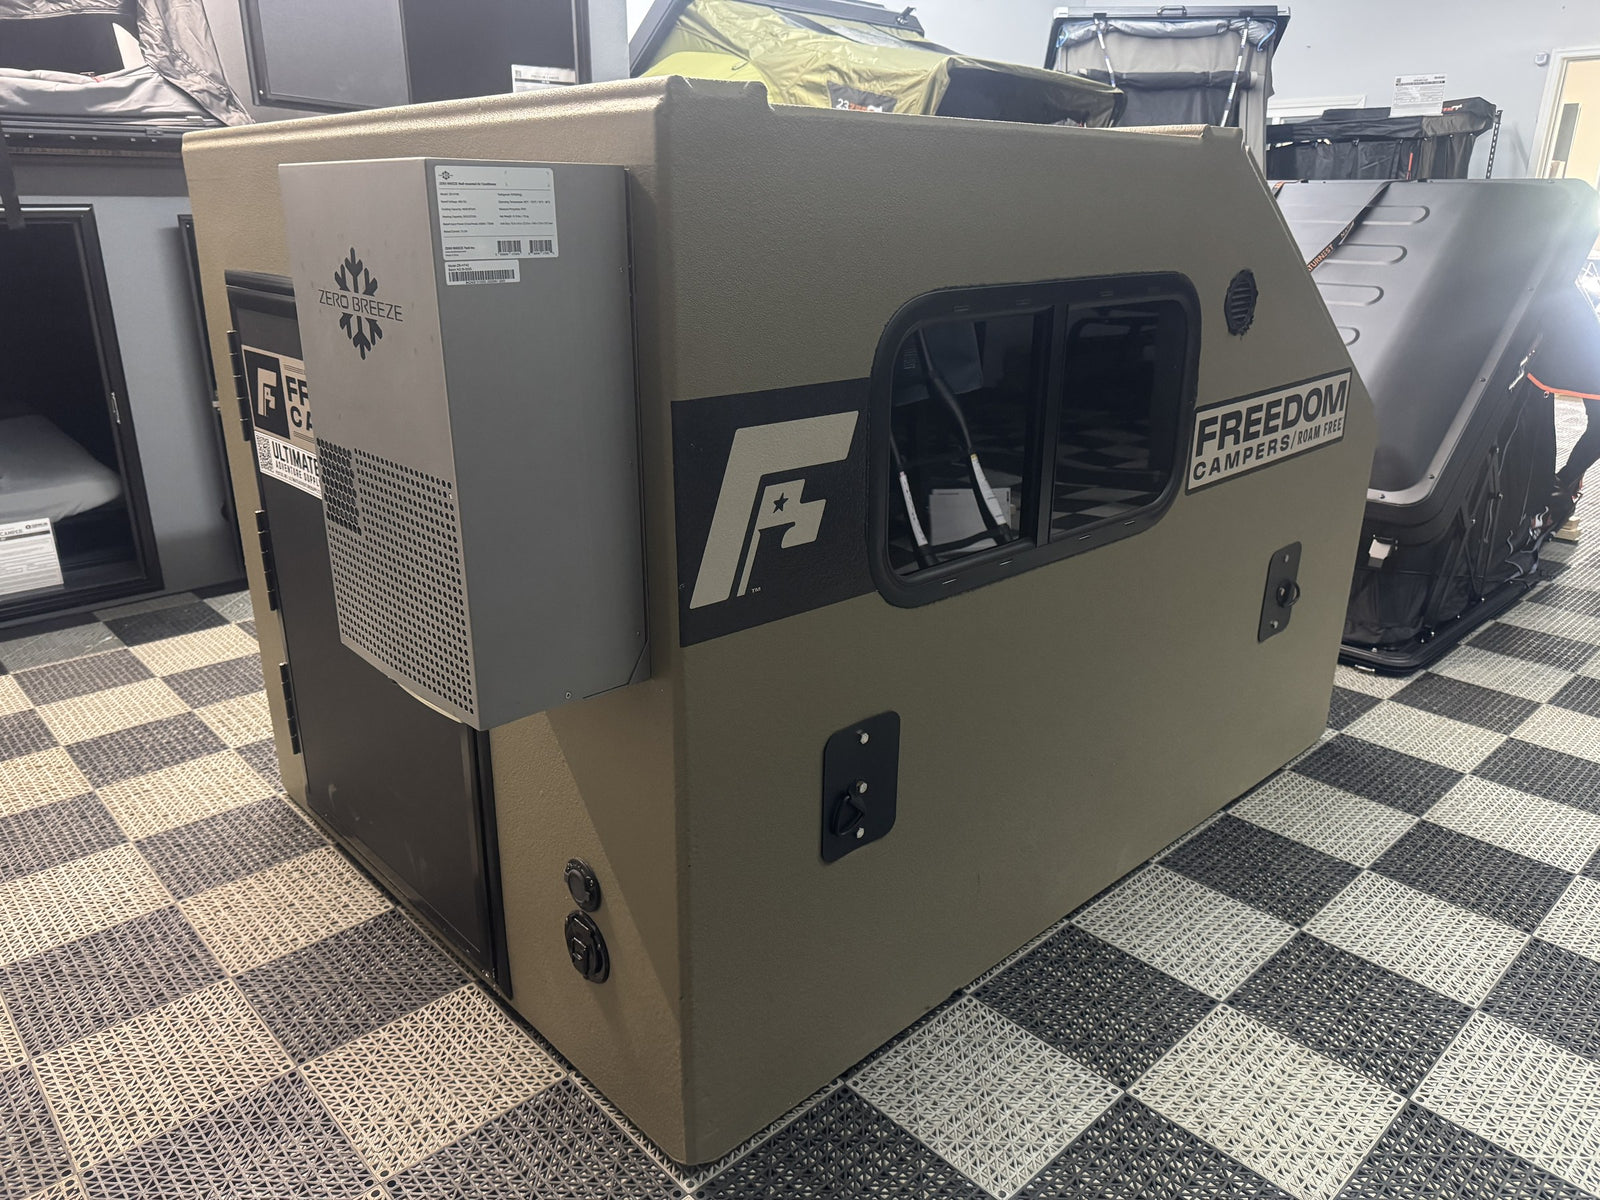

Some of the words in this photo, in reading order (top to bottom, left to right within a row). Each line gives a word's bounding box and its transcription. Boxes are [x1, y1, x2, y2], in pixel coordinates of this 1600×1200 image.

[318, 289, 349, 309] ZERO
[352, 296, 404, 322] BREEZE
[1195, 380, 1348, 458] FREEDOM
[1323, 418, 1342, 437] FREE
[271, 441, 320, 478] ULTIMATE
[303, 472, 320, 487] SUPPL
